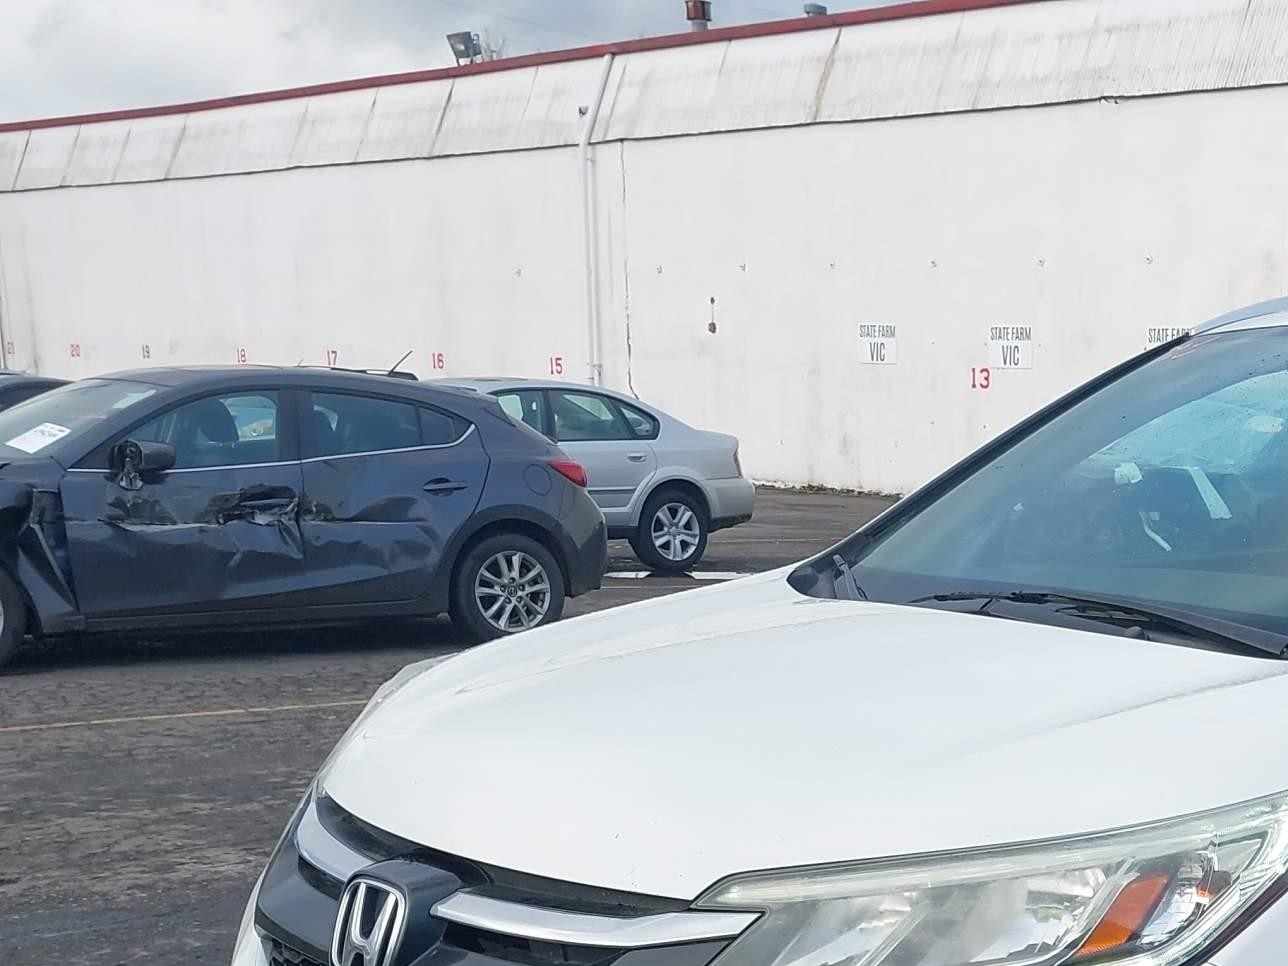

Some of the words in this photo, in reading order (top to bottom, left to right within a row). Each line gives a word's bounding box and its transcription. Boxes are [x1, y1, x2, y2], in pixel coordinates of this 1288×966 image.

[859, 324, 877, 338] STATE
[878, 324, 896, 338] FARM
[990, 326, 1010, 341] STATE
[1011, 326, 1032, 341] FARM
[1148, 327, 1169, 343] STATE
[1171, 327, 1193, 341] FAR
[70, 343, 81, 357] 20
[142, 344, 151, 359] 19
[236, 348, 247, 364] 18
[327, 350, 338, 366] 17
[869, 341, 886, 362] VIC
[1001, 345, 1020, 366] VIC
[432, 352, 444, 369] 16
[549, 356, 563, 375] 15
[971, 367, 990, 389] 13
